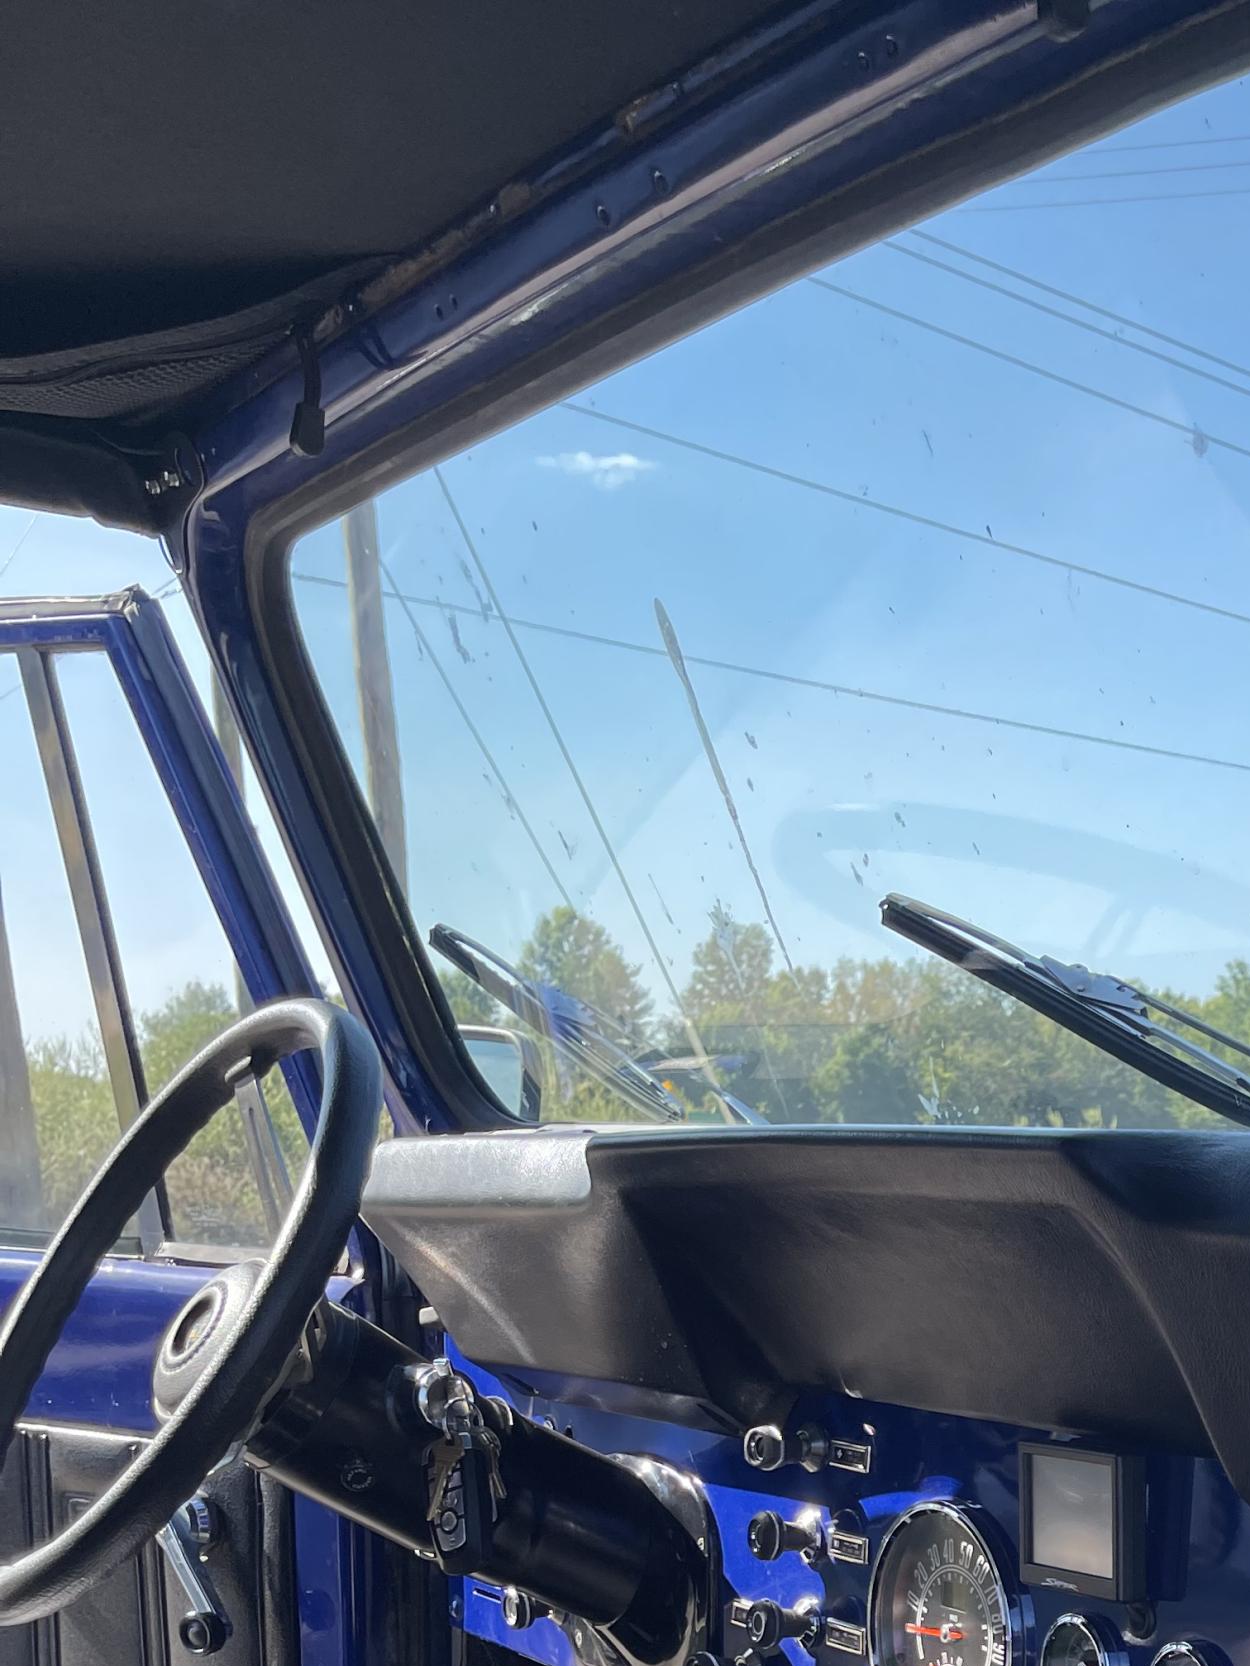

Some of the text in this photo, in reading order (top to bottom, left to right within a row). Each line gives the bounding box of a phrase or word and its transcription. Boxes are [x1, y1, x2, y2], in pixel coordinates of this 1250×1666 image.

[927, 1543, 941, 1571] 30
[943, 1538, 955, 1563] 40
[959, 1541, 974, 1569] 50
[914, 1561, 929, 1588] 20
[973, 1555, 990, 1584] 60
